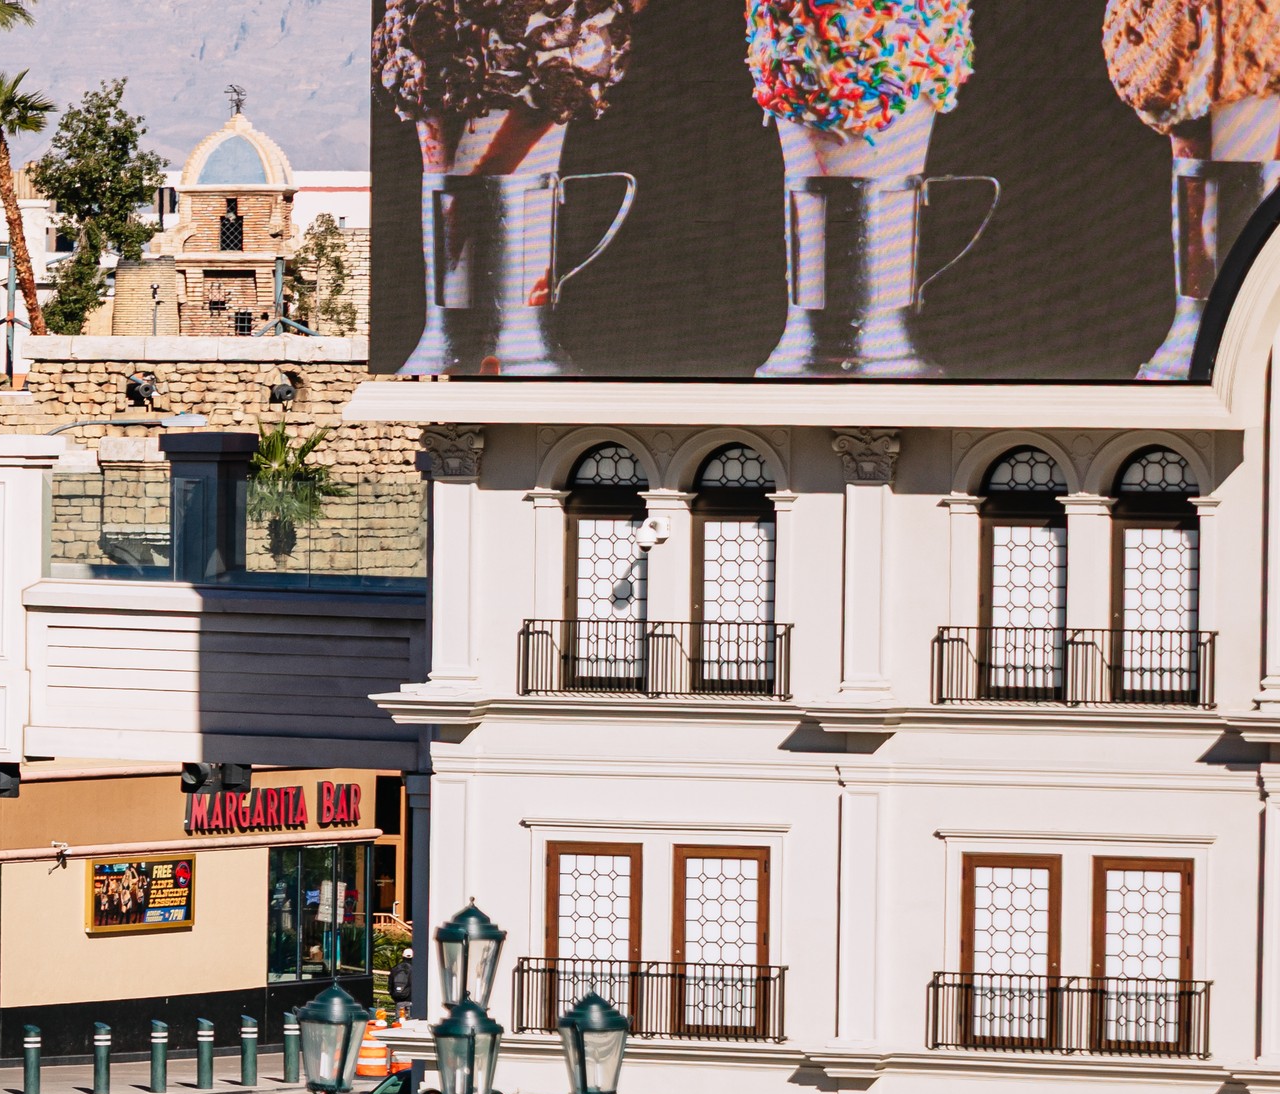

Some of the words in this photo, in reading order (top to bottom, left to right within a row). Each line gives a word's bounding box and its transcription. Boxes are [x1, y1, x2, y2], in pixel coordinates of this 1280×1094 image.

[189, 786, 308, 831] MARGARITA
[320, 781, 361, 824] BAR
[152, 864, 173, 879] FREE
